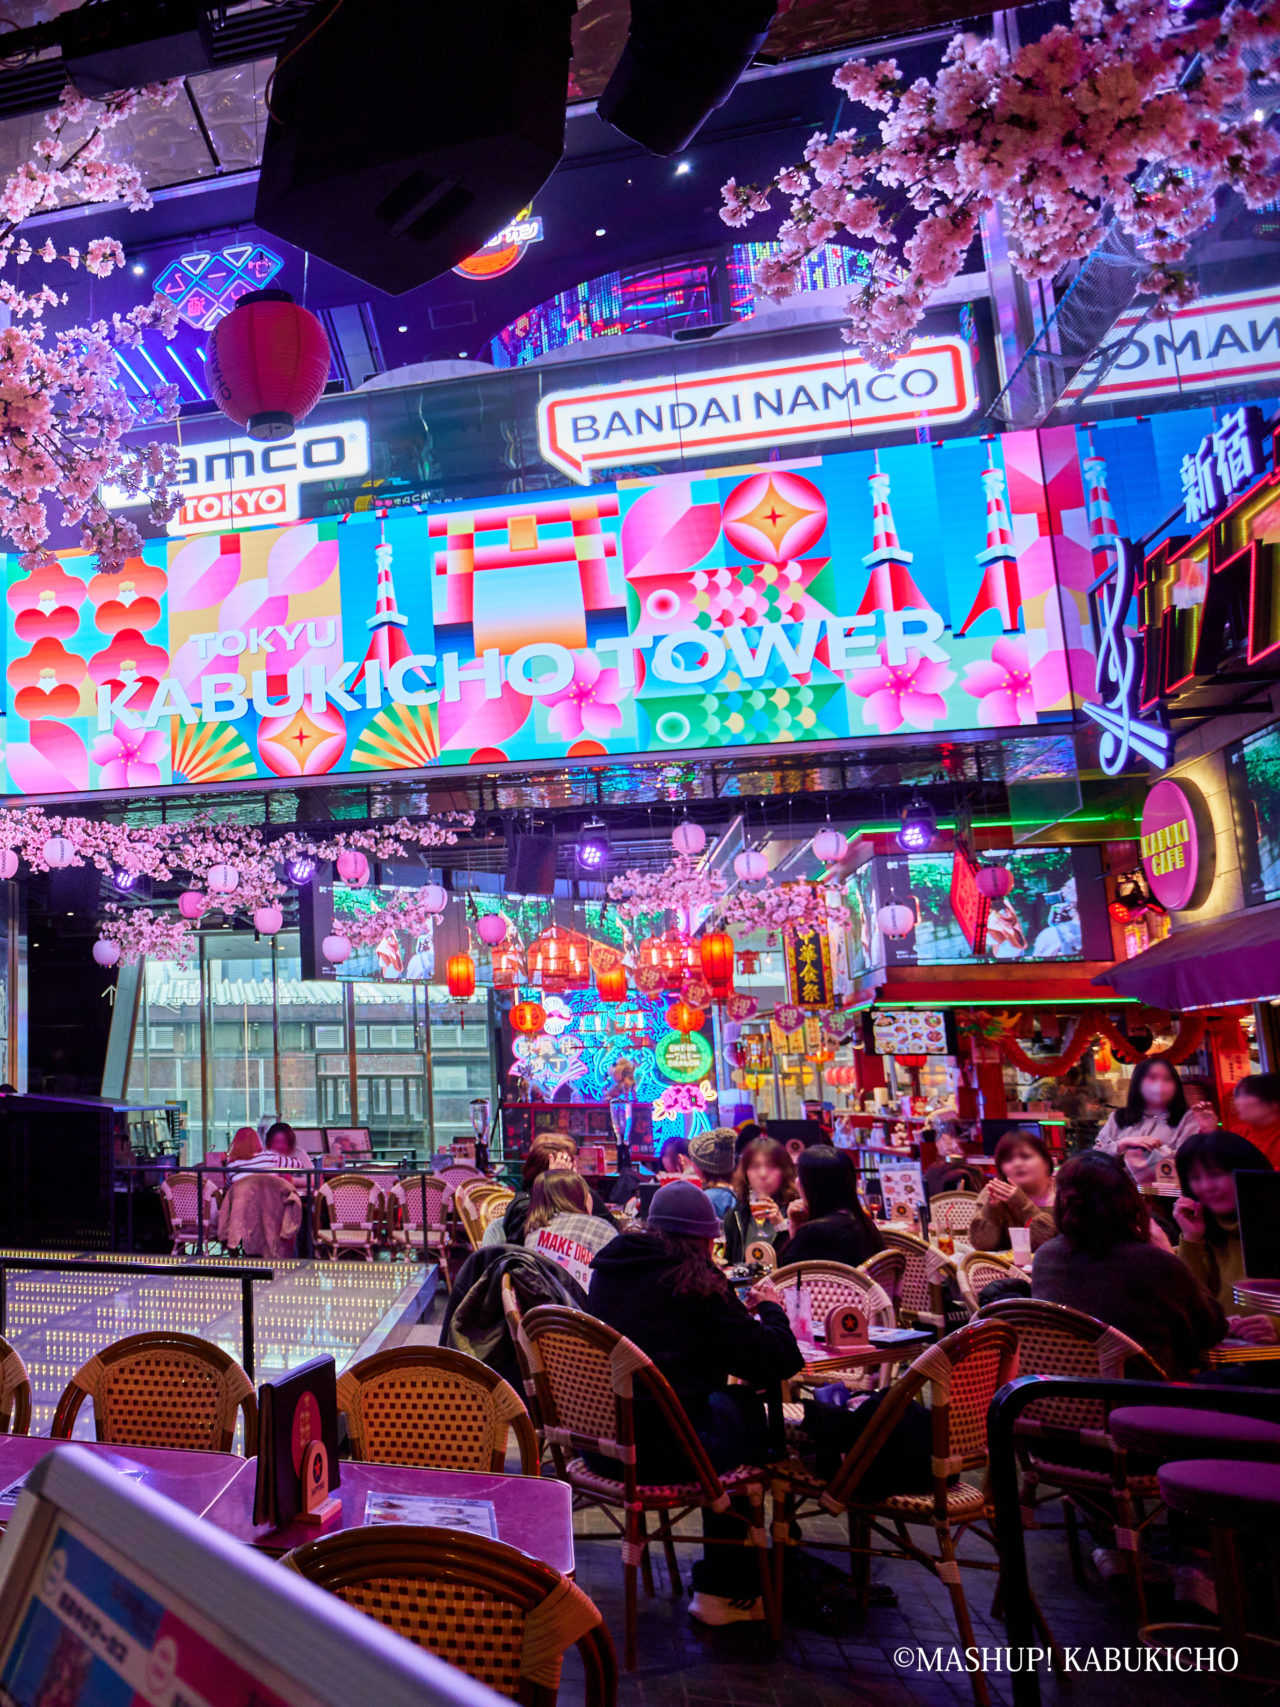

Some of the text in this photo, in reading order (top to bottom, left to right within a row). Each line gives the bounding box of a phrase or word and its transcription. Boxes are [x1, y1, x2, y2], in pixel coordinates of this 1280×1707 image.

[571, 368, 938, 443] BANDAI NAMCO
[145, 436, 345, 487] amco
[1179, 407, 1254, 523] 新宿
[184, 488, 283, 521] TOKYO
[189, 620, 336, 659] TOKYU
[96, 611, 953, 731] KABUKICHO TOWER
[1141, 819, 1189, 858] KABUKI
[1151, 845, 1185, 877] CAFE
[537, 1230, 574, 1258] MAKE
